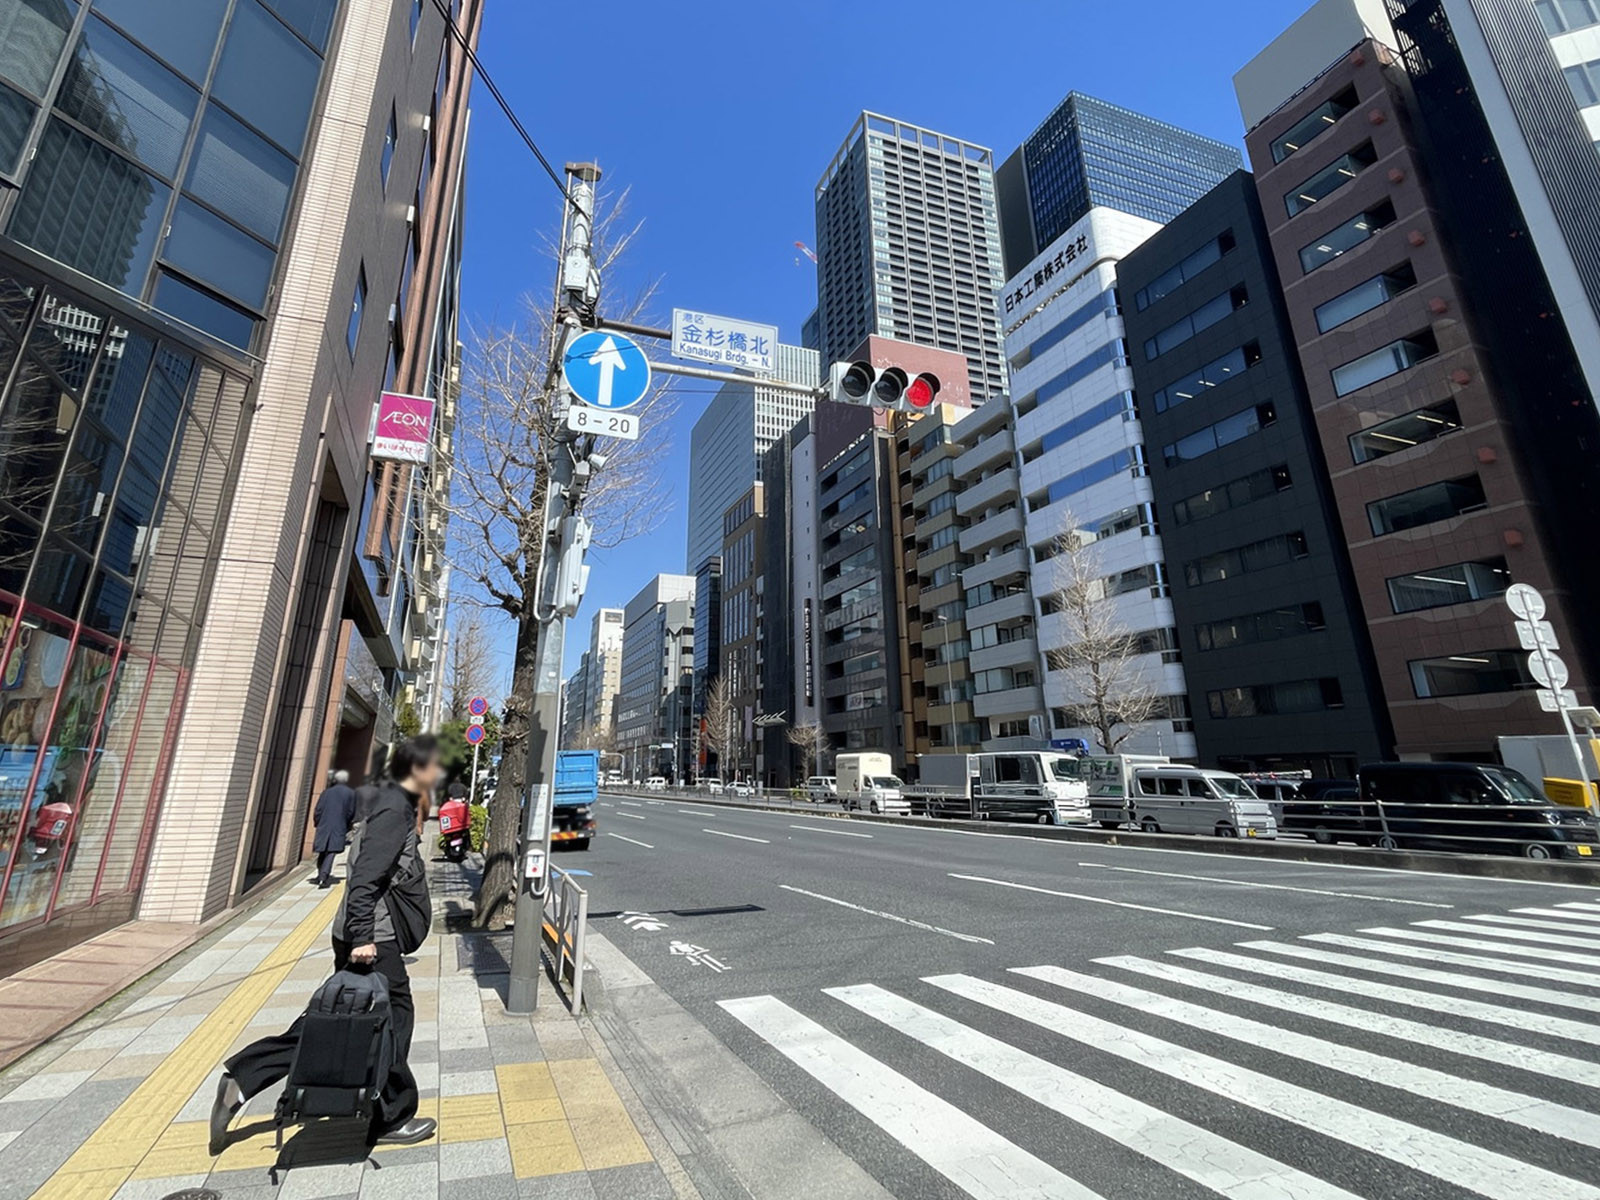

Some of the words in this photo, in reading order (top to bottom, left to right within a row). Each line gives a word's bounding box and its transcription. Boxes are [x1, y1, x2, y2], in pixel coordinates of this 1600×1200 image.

[682, 324, 769, 355] 金杉橋北
[680, 343, 722, 361] Kanasugi
[725, 350, 749, 366] Brdg.
